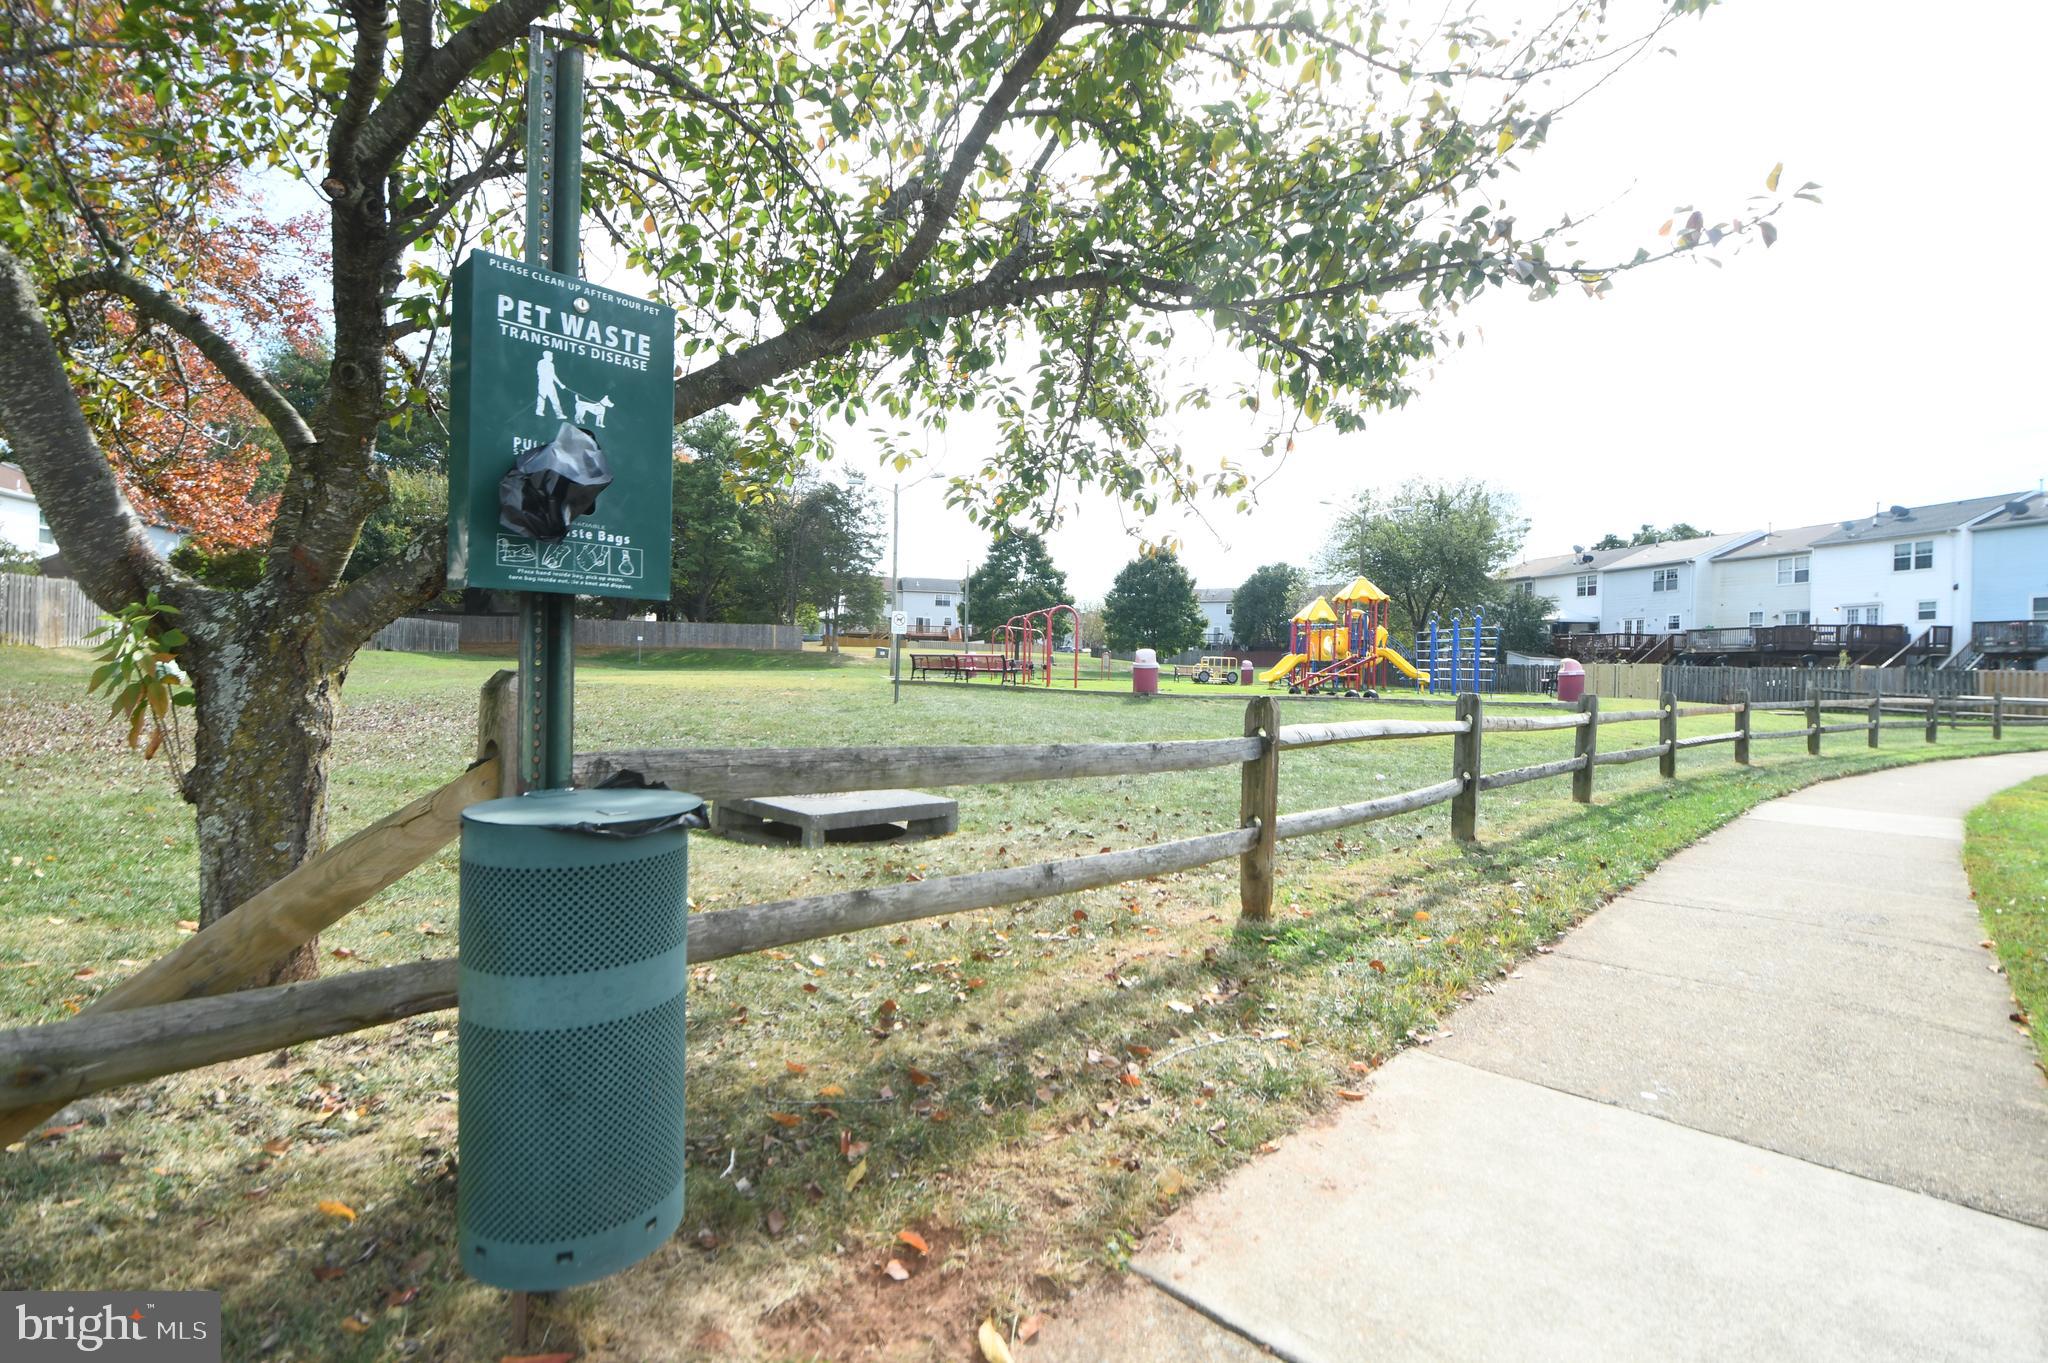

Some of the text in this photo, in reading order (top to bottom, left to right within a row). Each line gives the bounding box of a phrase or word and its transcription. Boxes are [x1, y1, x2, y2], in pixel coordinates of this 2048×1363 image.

[489, 258, 660, 316] PLEASE CLEAN UP AFTER YOUR PET
[497, 294, 650, 356] PET WASTE
[499, 323, 648, 372] TRANSMITS DISEASE
[566, 529, 631, 546] ste Bags
